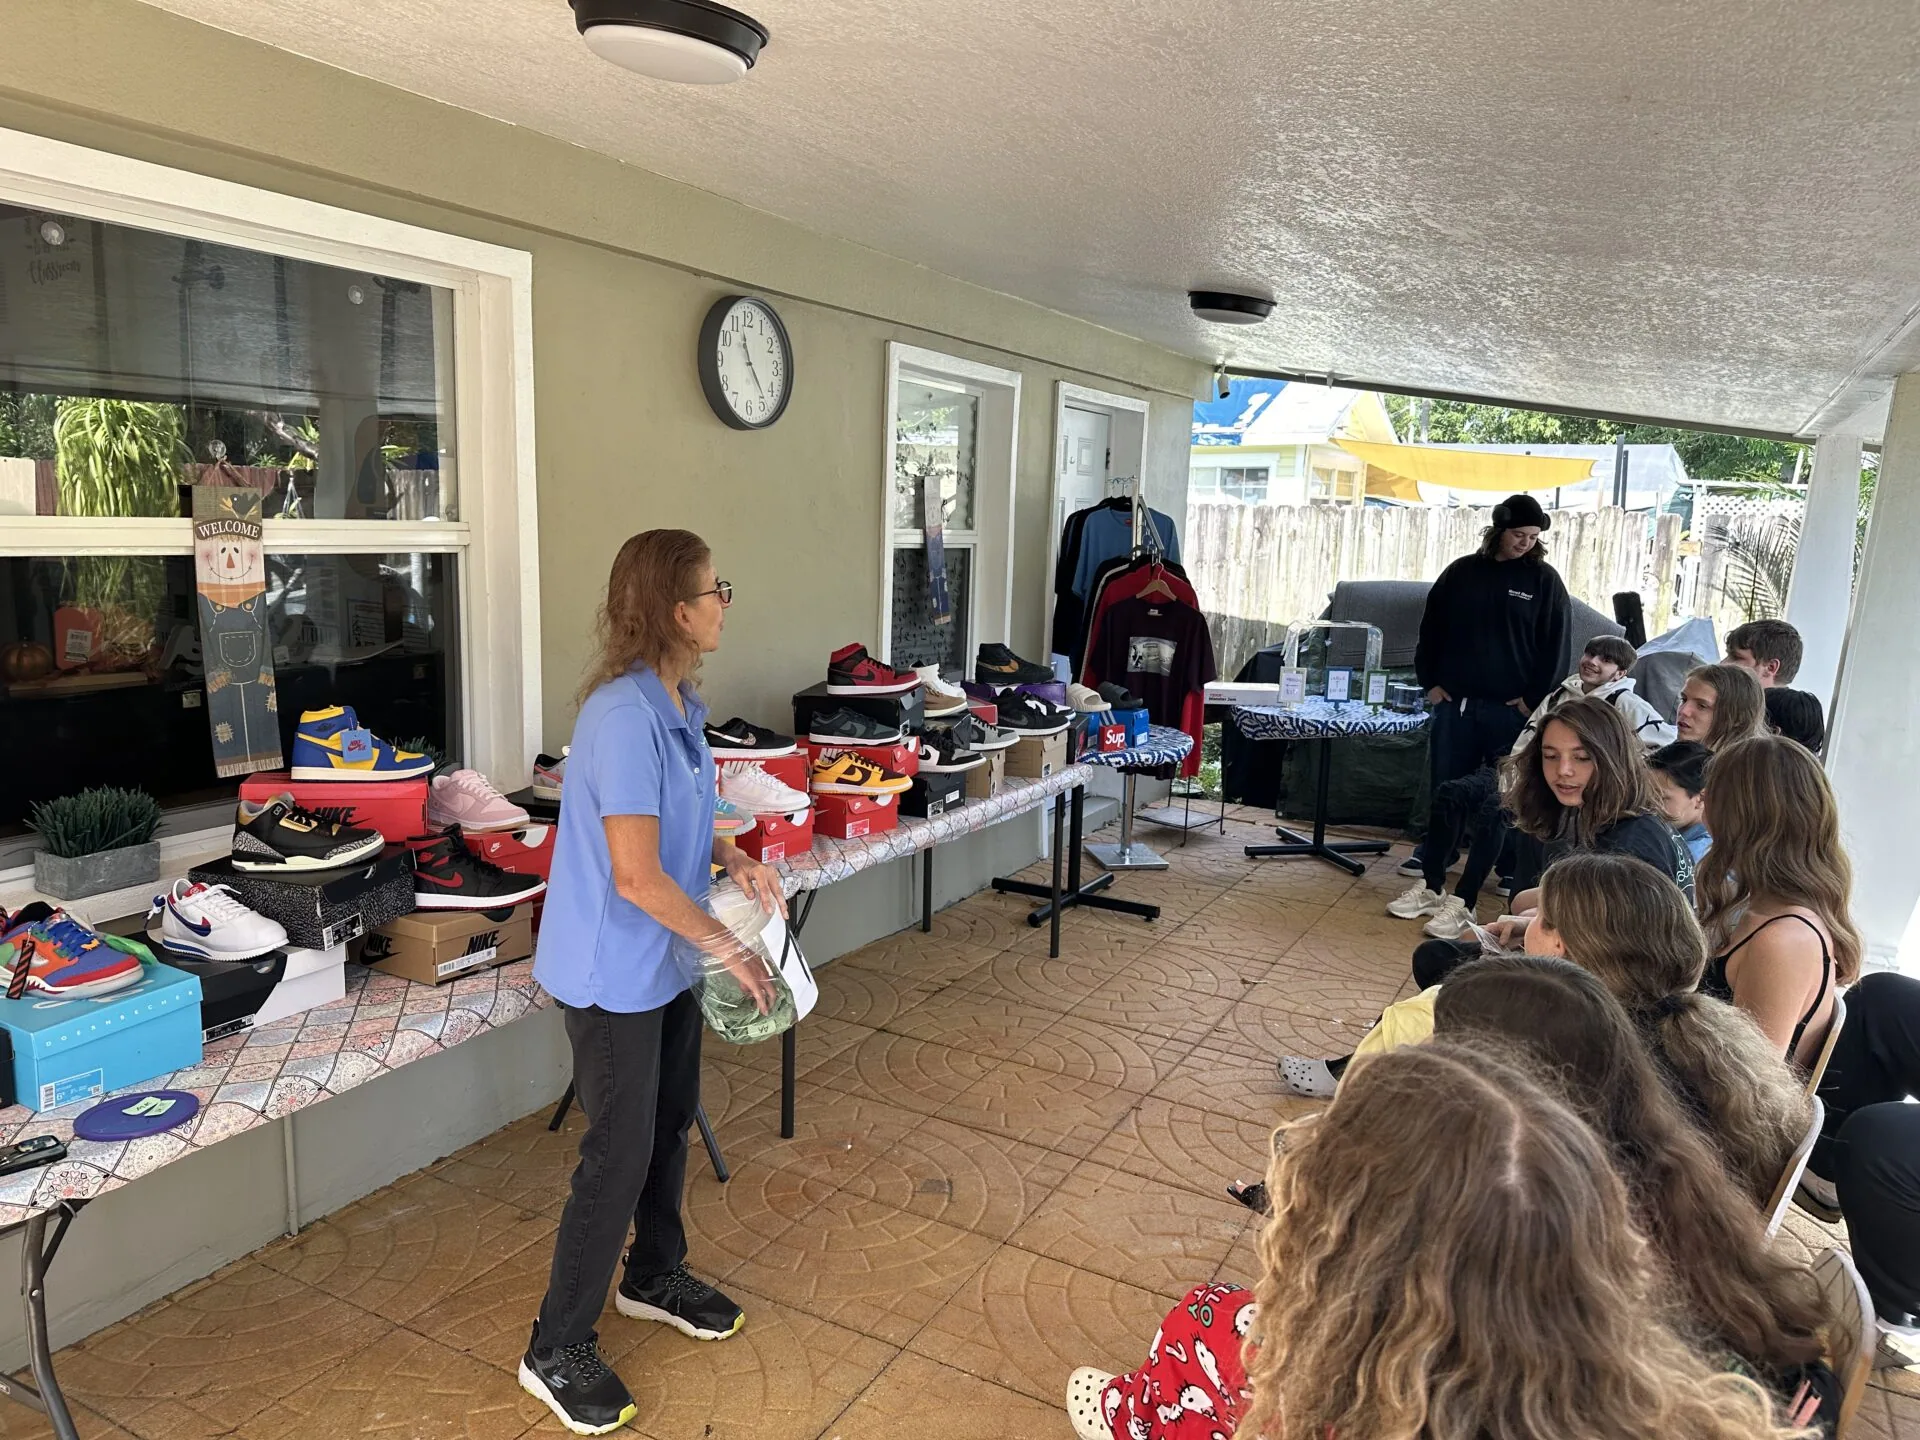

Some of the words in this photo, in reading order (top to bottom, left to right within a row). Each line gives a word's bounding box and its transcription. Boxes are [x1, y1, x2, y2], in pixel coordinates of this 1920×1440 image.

[731, 315, 739, 332] 11
[742, 310, 753, 328] 12
[759, 320, 764, 336] 1
[722, 330, 731, 347] 10
[766, 336, 773, 354] 2
[717, 351, 724, 367] 9
[772, 360, 779, 376] 3
[722, 375, 728, 391] 8
[768, 382, 774, 397] 4
[732, 392, 738, 408] 7
[746, 400, 752, 416] 6
[759, 396, 765, 412] 5
[198, 520, 260, 538] WELCOME
[1105, 729, 1125, 748] Sup
[366, 932, 393, 953] NIKE
[467, 930, 500, 954] NIKE
[45, 990, 193, 1047] DOERNBECHER
